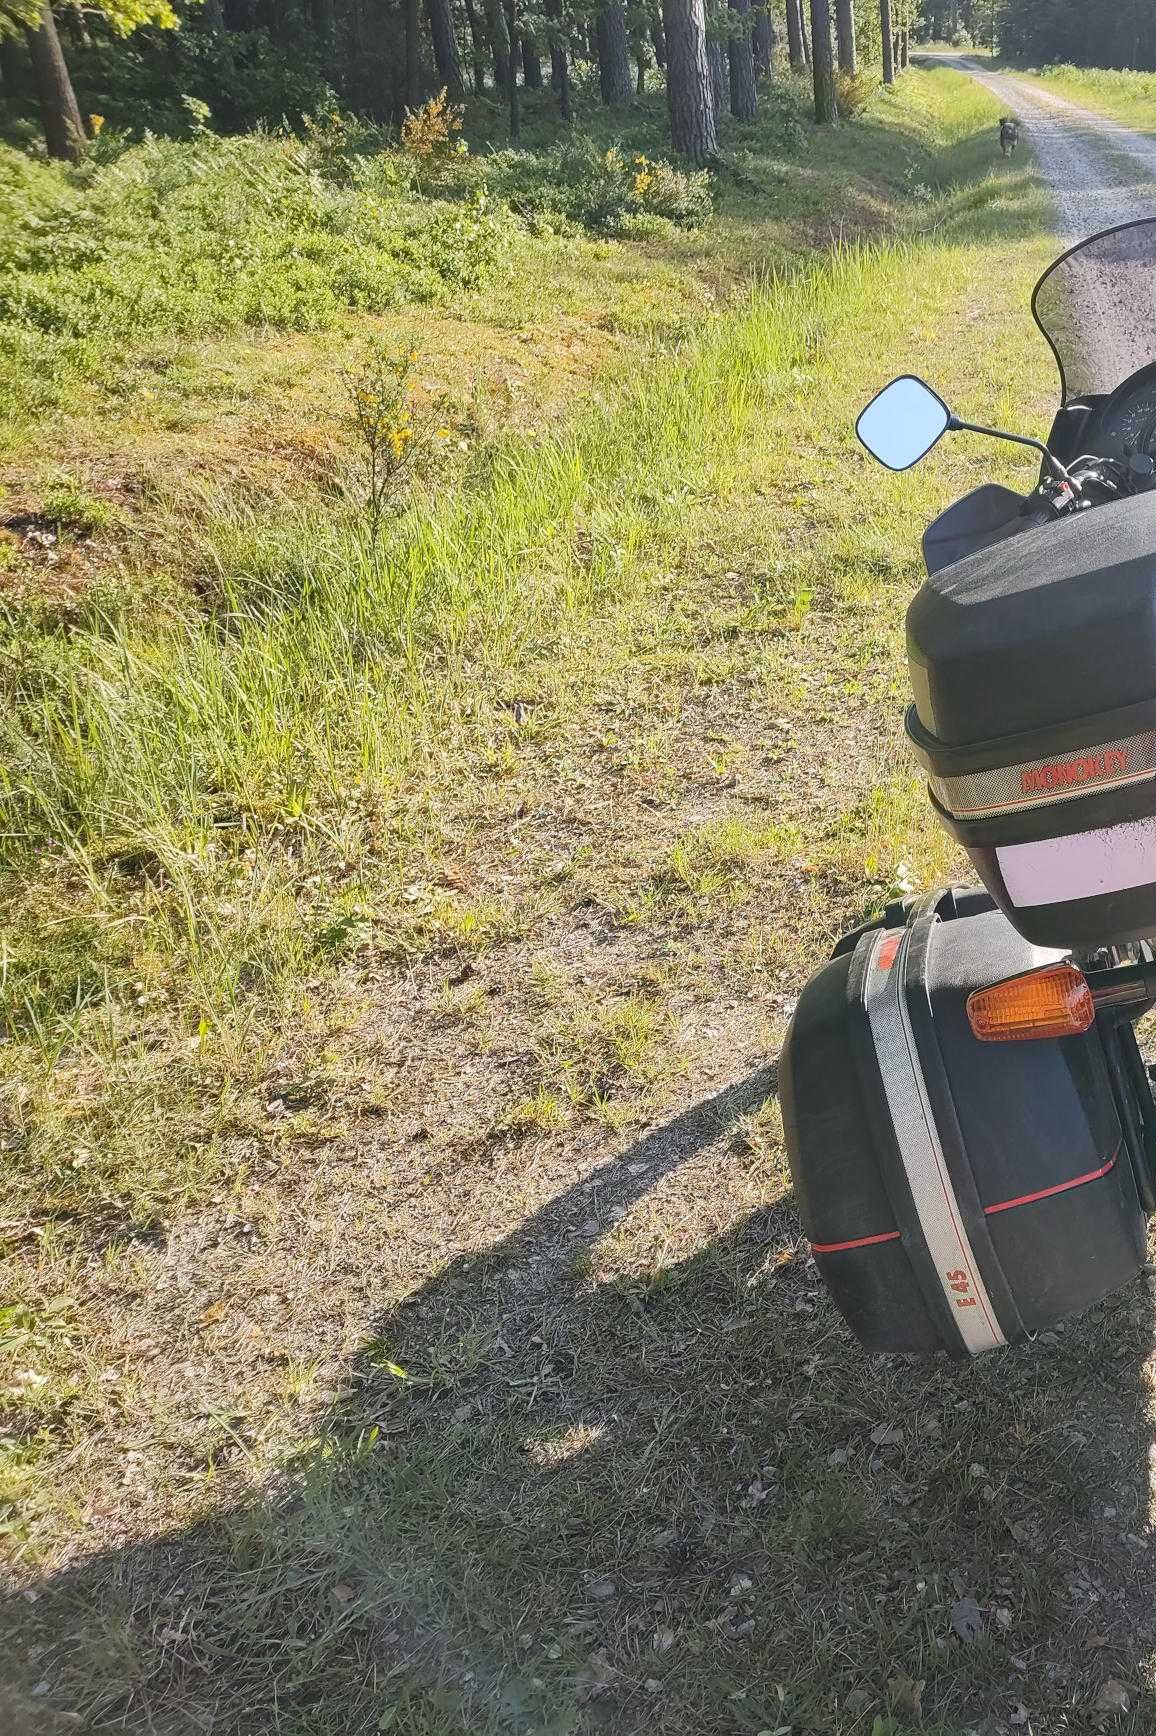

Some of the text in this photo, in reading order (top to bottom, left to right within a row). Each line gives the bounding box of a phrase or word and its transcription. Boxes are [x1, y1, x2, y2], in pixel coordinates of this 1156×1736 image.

[1021, 748, 1127, 793] MONOKEY
[946, 1269, 977, 1307] E 45
